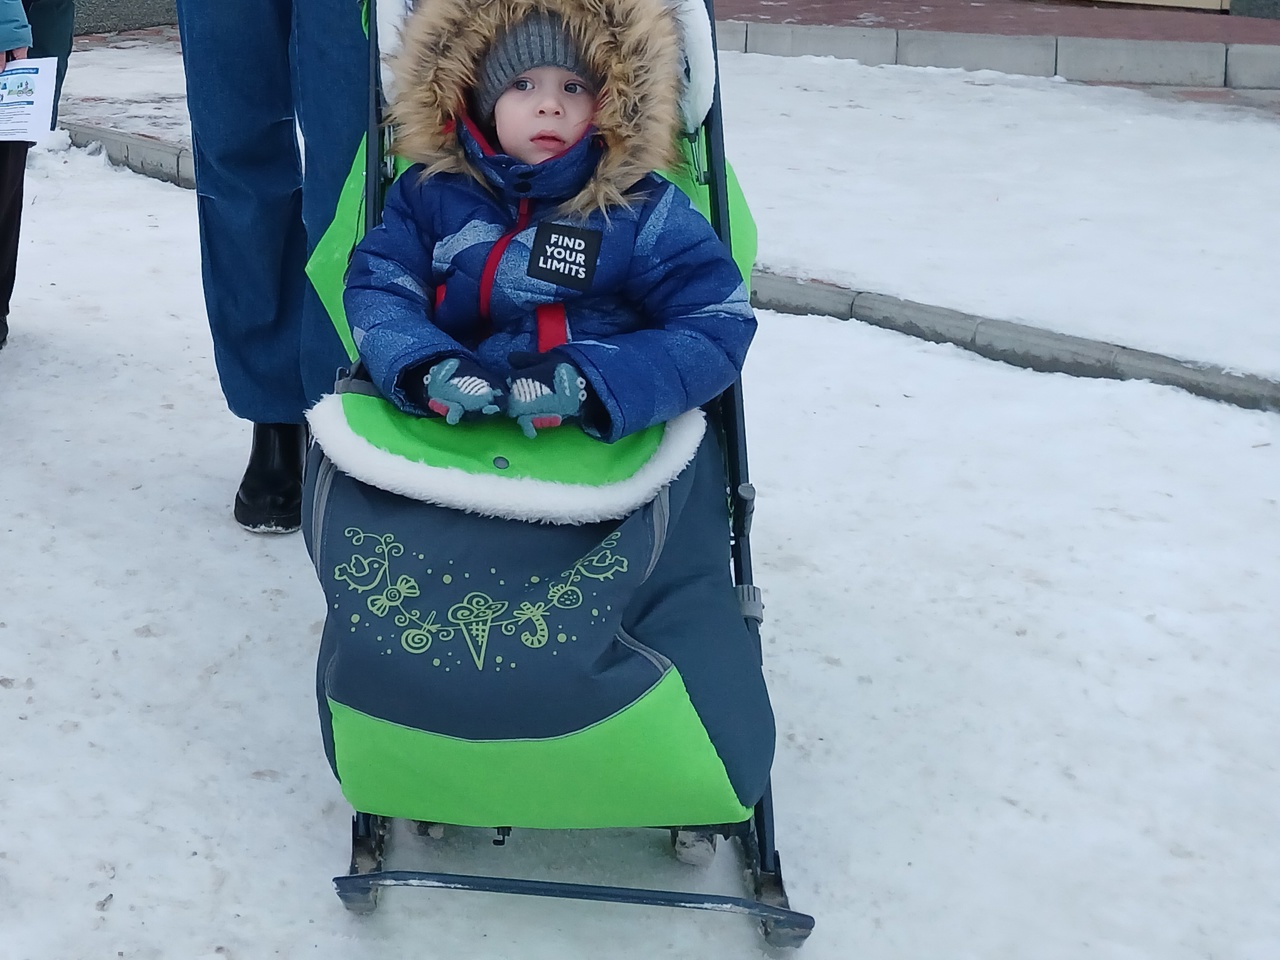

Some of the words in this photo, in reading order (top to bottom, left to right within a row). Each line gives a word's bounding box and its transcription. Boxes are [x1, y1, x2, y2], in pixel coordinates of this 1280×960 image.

[550, 233, 585, 250] FIND
[545, 245, 585, 265] YOUR
[539, 256, 586, 278] LIMITS
